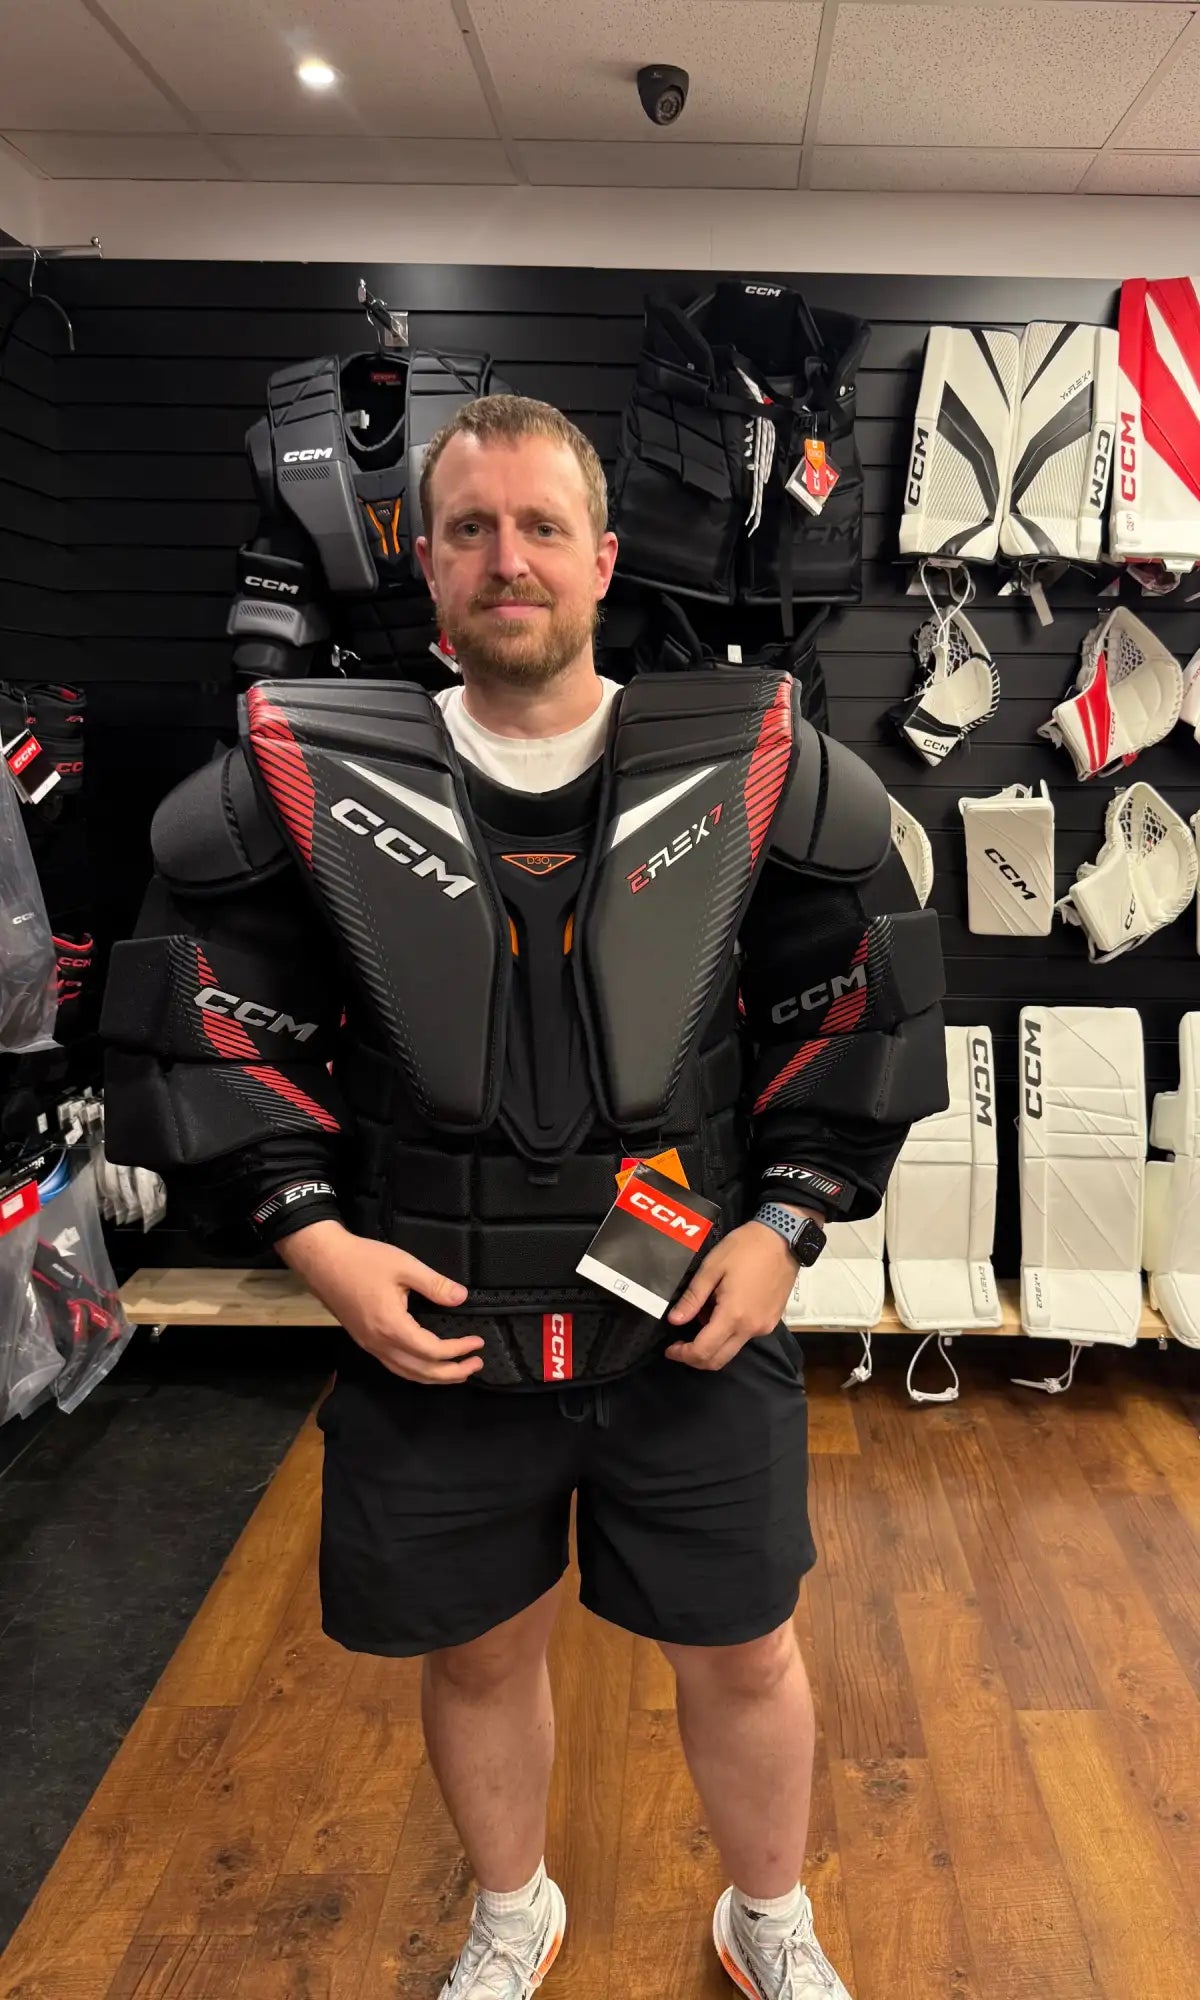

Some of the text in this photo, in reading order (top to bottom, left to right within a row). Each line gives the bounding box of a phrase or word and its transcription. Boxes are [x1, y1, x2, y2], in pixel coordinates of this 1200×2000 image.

[745, 285, 782, 297] CCM
[283, 447, 333, 462] CCM
[908, 427, 929, 507] CCM
[1090, 430, 1110, 508] CCM
[1121, 412, 1136, 502] CCM
[244, 575, 299, 594] CCM
[13, 742, 37, 769] CCM
[923, 738, 949, 753] CCM
[330, 798, 477, 899] CCM
[625, 803, 724, 895] EFLEX7
[985, 848, 1037, 900] CCM
[194, 987, 318, 1043] CCM
[771, 965, 867, 1025] CCM
[972, 1037, 992, 1127] CCM
[1024, 1019, 1043, 1120] CCM
[629, 1191, 701, 1237] CCM
[551, 1313, 565, 1379] CCM
